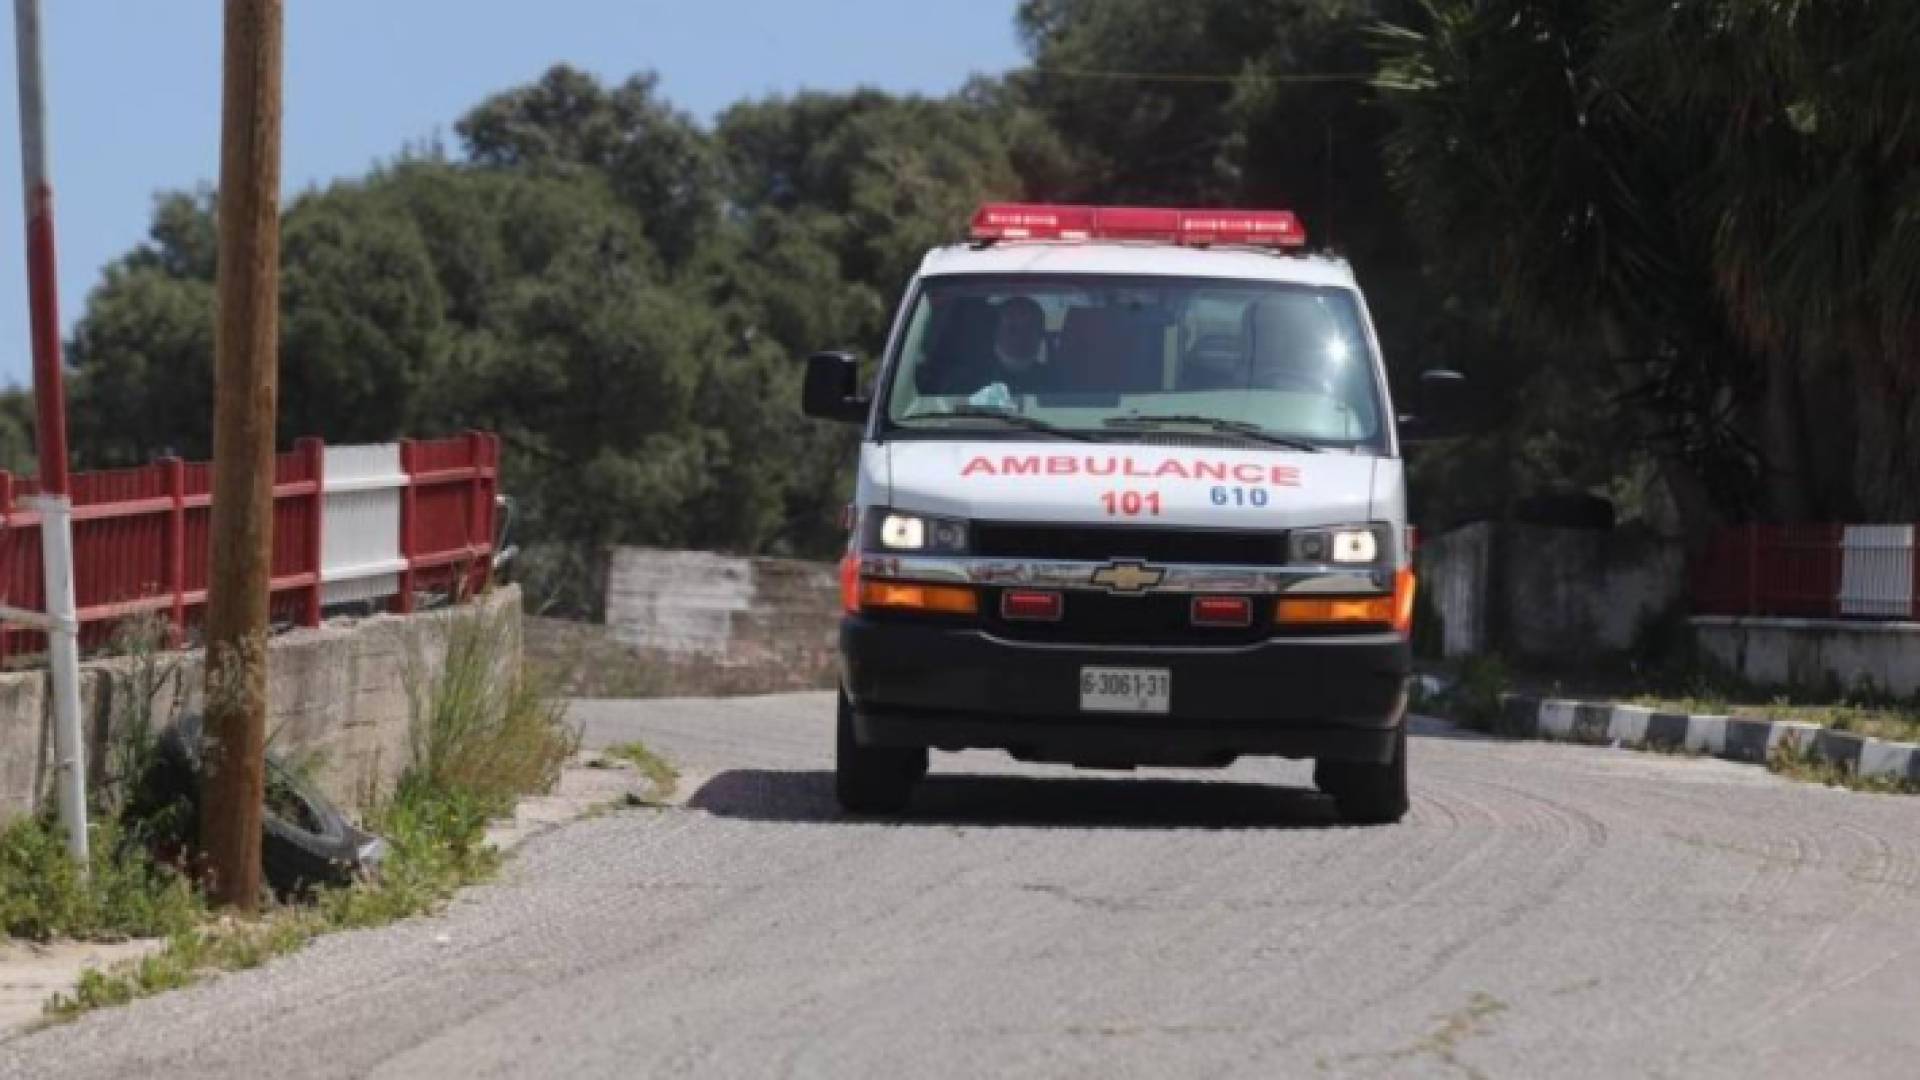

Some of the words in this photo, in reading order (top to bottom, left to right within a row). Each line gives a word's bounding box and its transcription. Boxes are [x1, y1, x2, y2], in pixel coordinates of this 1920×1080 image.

[961, 455, 1301, 486] AMBULANCE
[1101, 490, 1161, 516] 101
[1210, 486, 1269, 506] 610
